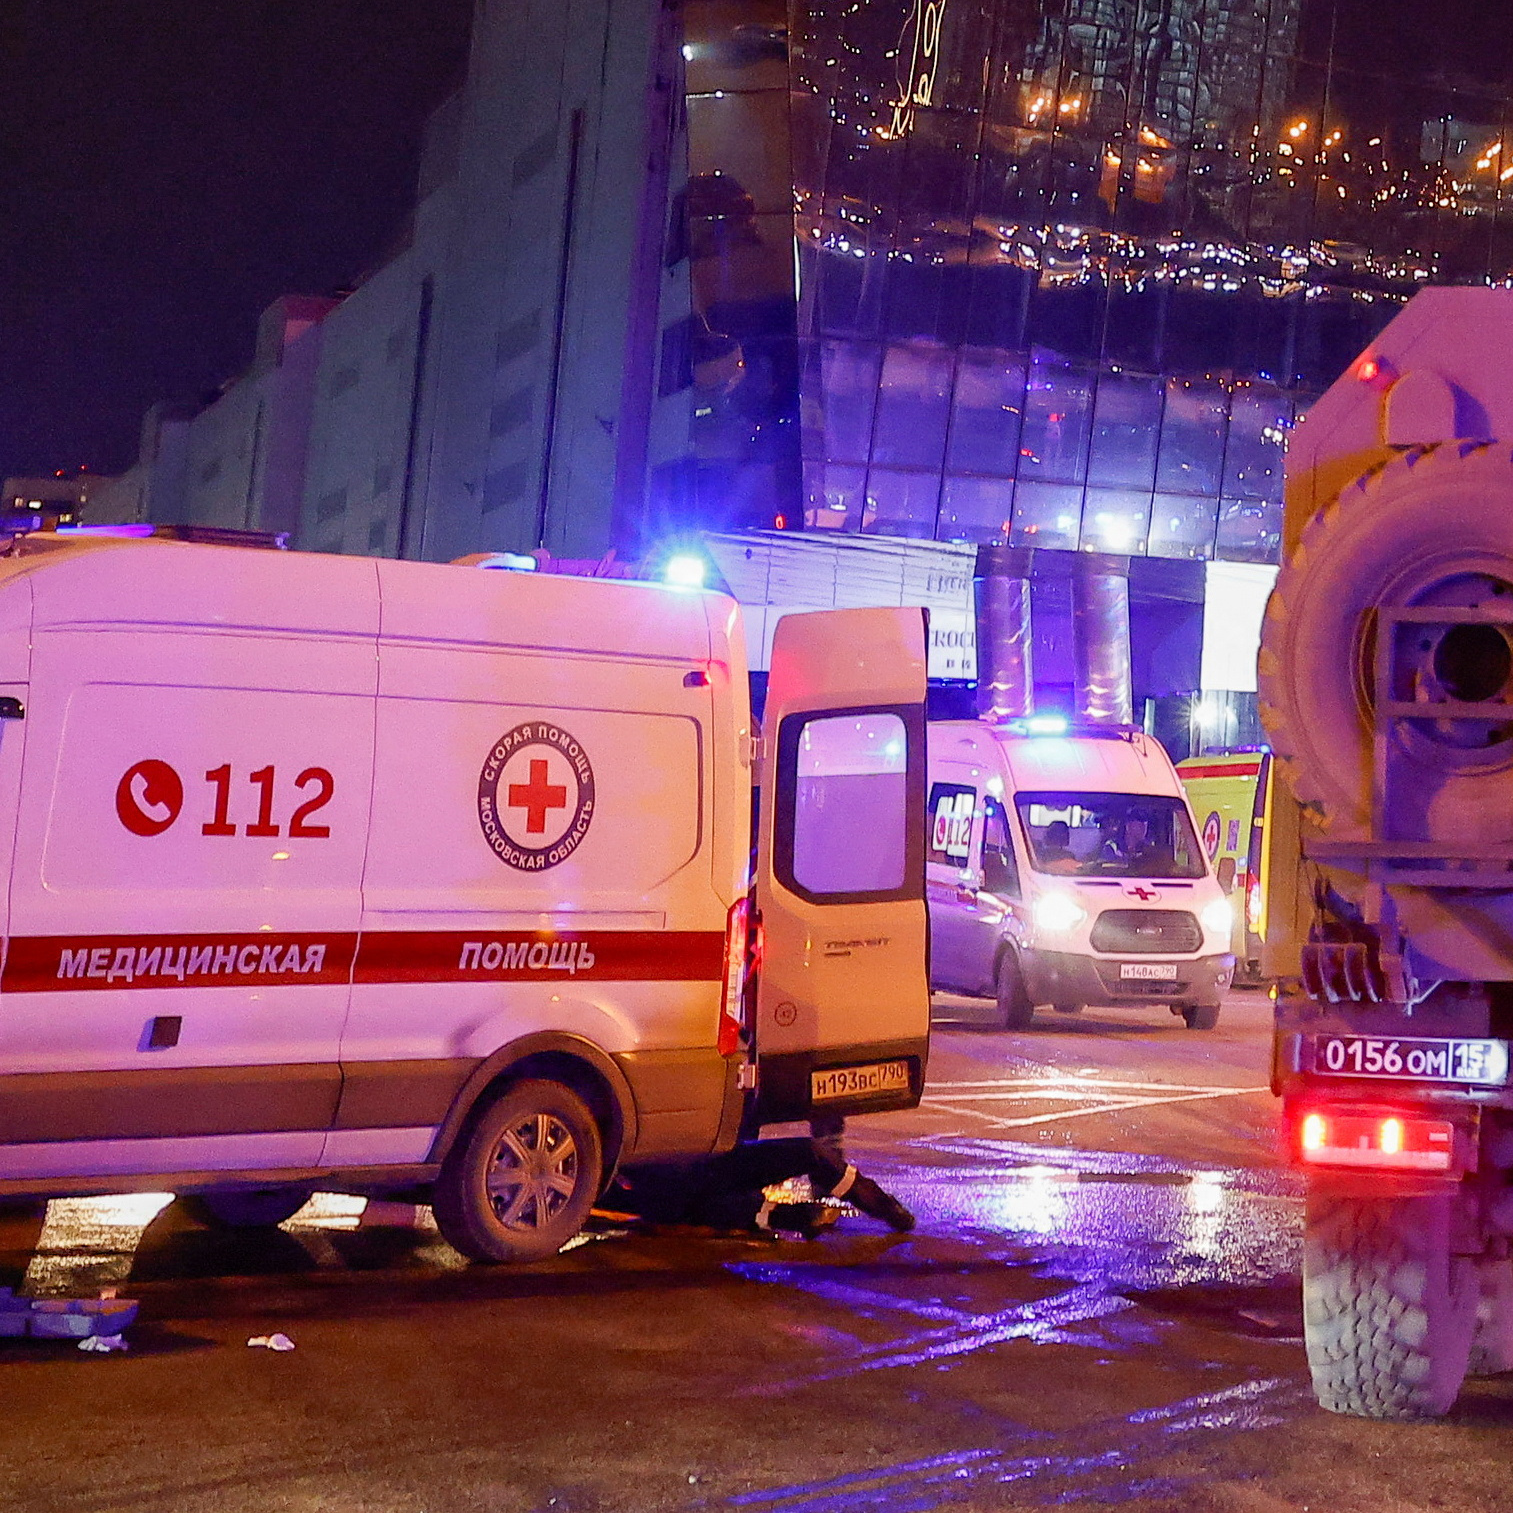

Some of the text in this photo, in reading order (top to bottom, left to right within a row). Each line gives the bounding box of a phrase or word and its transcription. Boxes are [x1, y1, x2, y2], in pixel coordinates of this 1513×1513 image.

[484, 725, 592, 785] СКОРАЯ ПОМОЩЬ
[200, 764, 335, 839] 112
[480, 796, 593, 869] МОСКОВСКАЯ ОБЛАСТЬ
[947, 815, 971, 846] 112
[55, 940, 597, 982] МЕДИЦИНСКАЯ ПОМОЩЬ
[816, 1064, 904, 1096] Н193ВС 790
